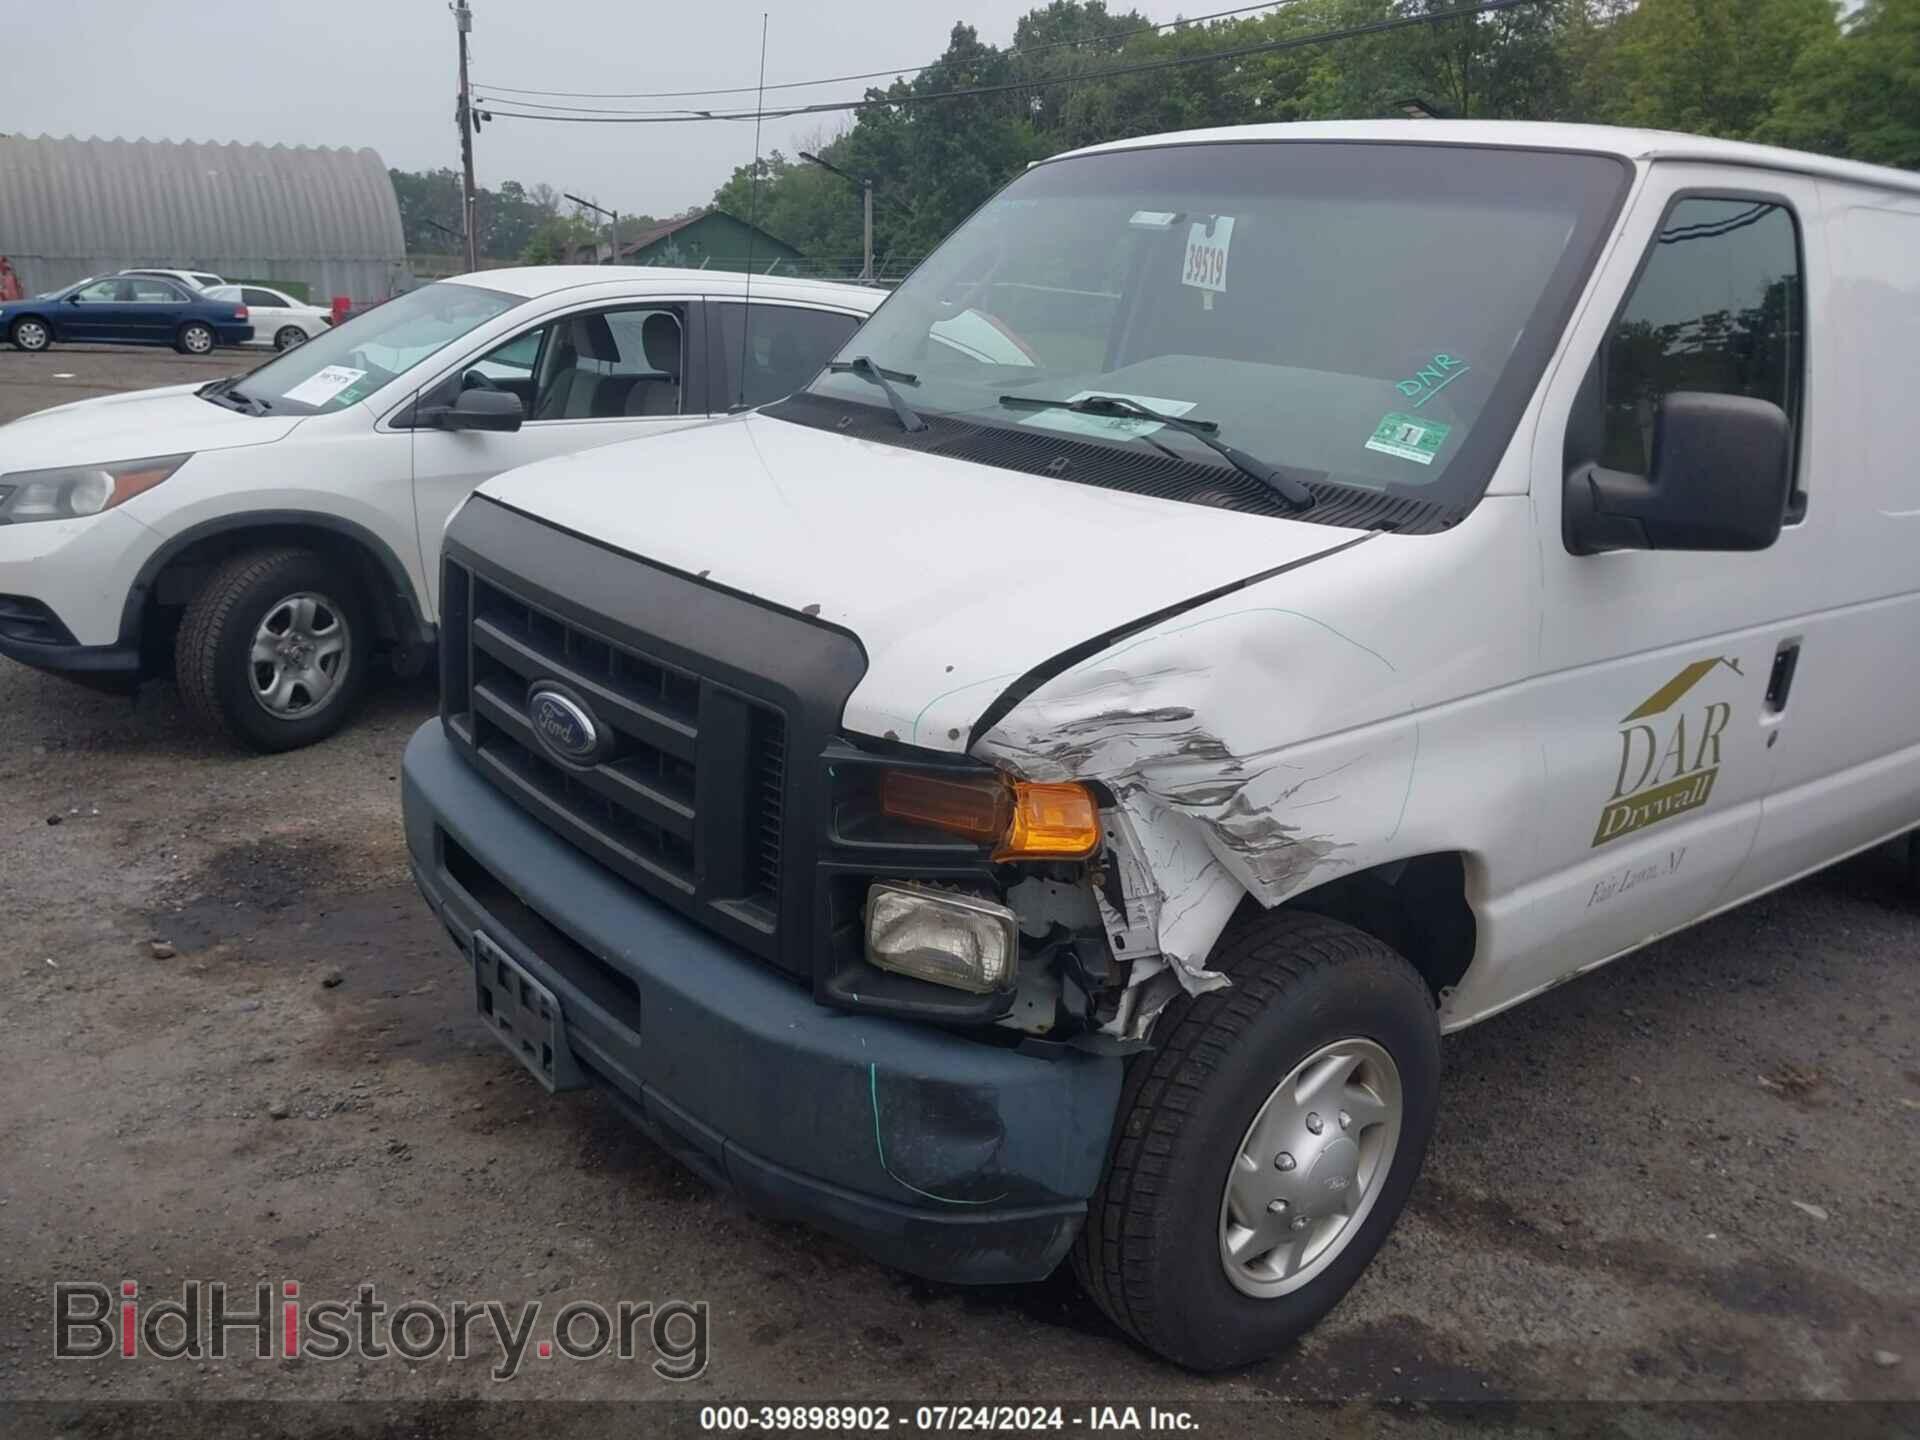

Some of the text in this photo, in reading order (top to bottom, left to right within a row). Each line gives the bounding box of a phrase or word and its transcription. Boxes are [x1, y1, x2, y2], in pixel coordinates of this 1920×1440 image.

[1186, 244, 1224, 286] 39519
[1395, 353, 1462, 397] DNR
[540, 701, 574, 743] Ford
[1609, 702, 1730, 801] DAR
[1601, 774, 1711, 836] Drywall
